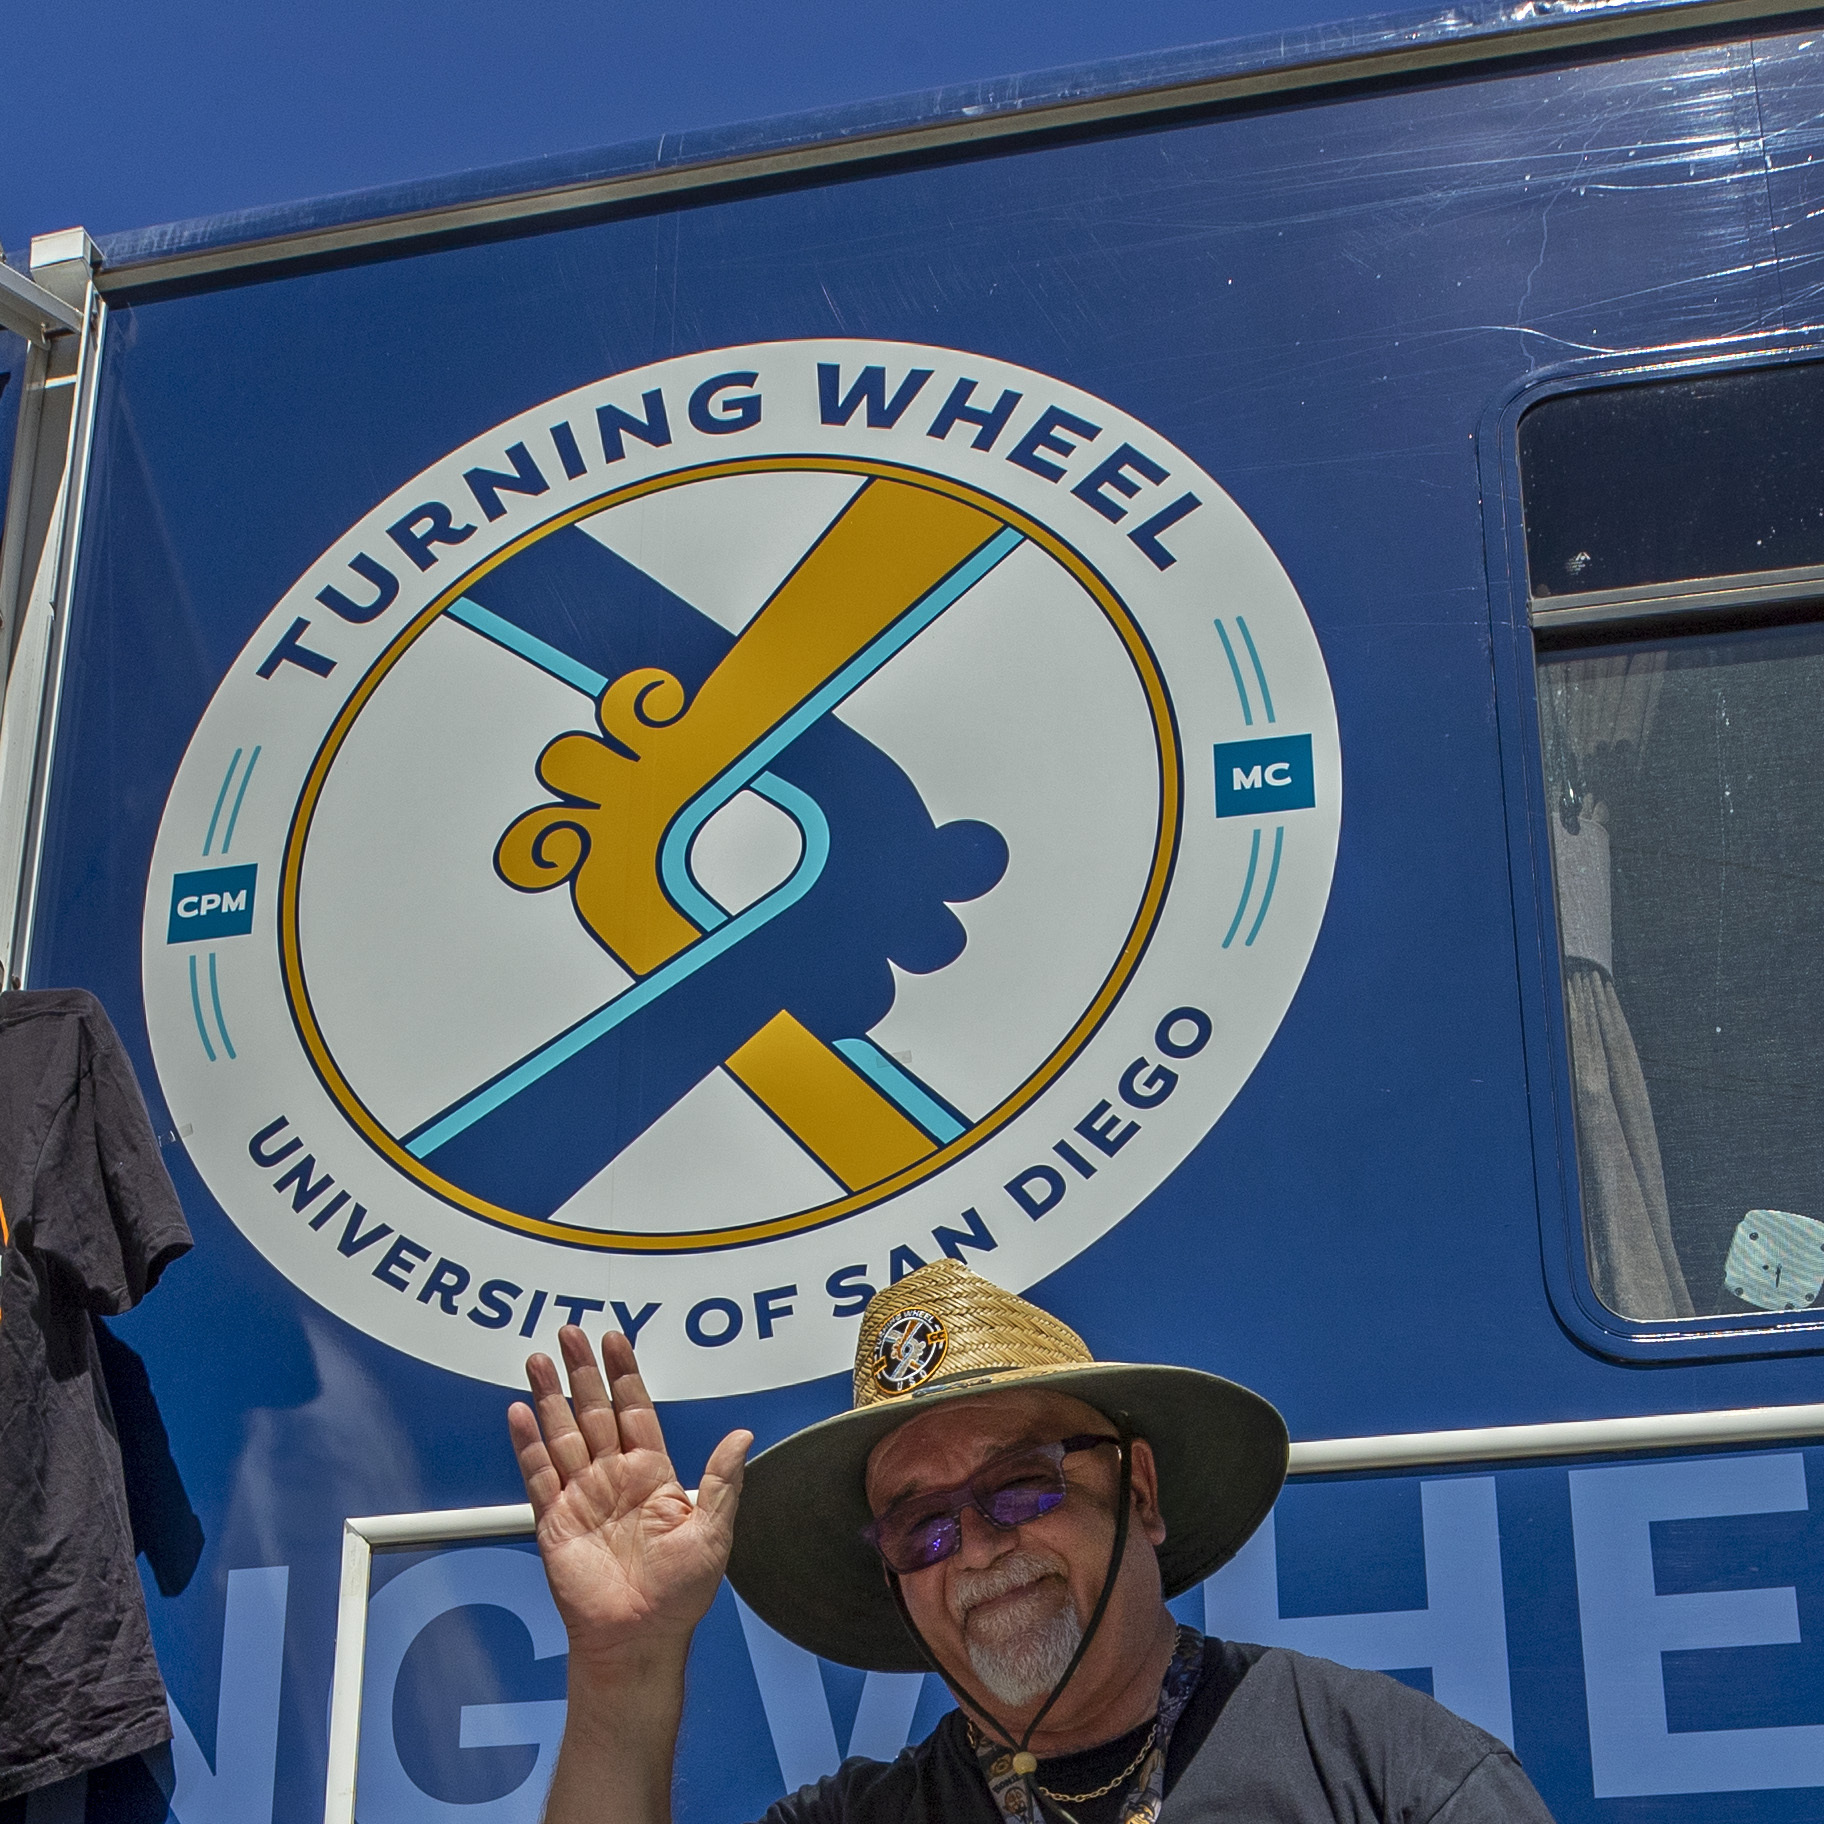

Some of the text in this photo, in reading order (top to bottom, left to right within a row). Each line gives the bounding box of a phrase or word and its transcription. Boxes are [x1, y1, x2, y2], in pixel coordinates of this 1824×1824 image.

[255, 361, 1203, 685] TURNING WHEEL
[1231, 761, 1293, 790] MC
[177, 888, 247, 918] CPM
[248, 1005, 1213, 1349] UNIVERSITY OF SAN DIEGO
[903, 1309, 935, 1324] WHEEL
